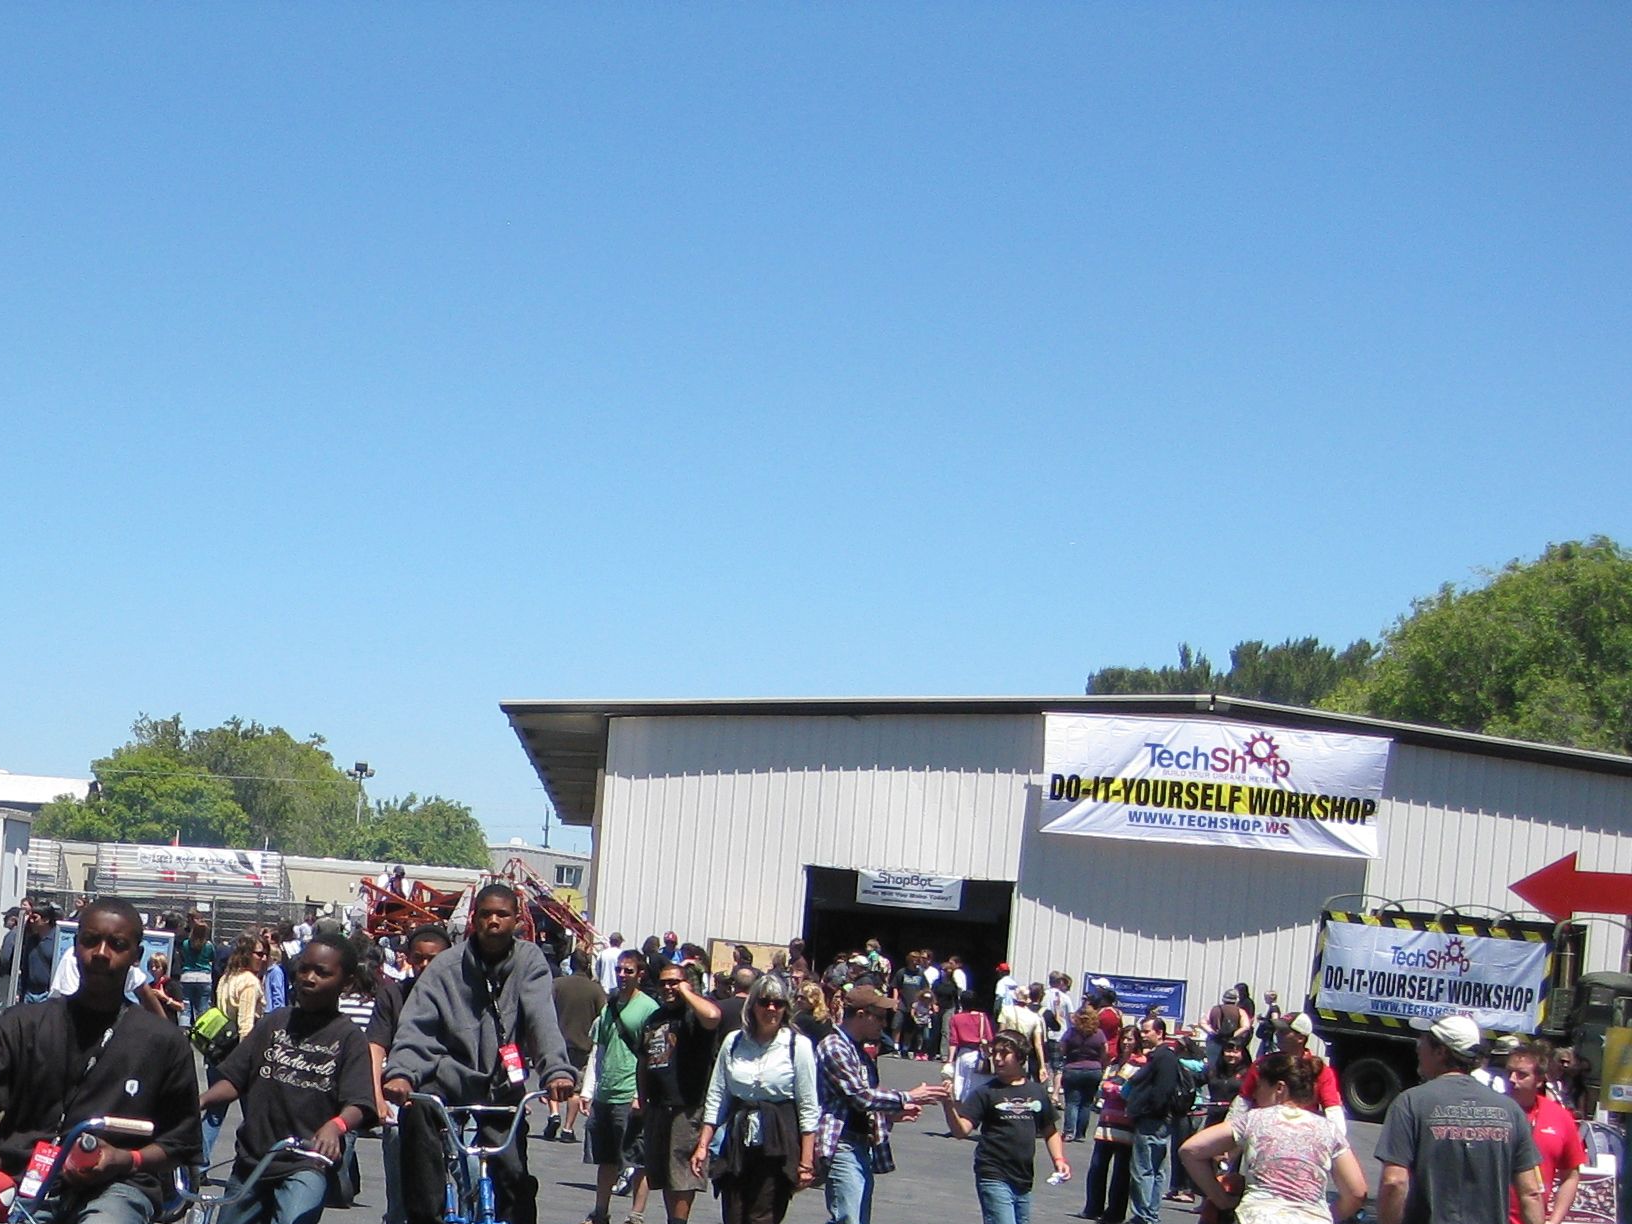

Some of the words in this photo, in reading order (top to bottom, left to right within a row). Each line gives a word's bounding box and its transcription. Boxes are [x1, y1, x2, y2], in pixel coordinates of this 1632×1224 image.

[1144, 731, 1290, 783] TechShop
[1188, 771, 1210, 779] YOUR
[1213, 773, 1247, 781] DREAMS
[1050, 773, 1242, 814] DO-IT-YOURSELF
[1248, 786, 1376, 826] WORKSHOP
[1128, 810, 1290, 835] WWW.TECHSHOP.WS
[873, 872, 943, 889] ShopBot
[1391, 937, 1470, 976] TechShop
[1324, 965, 1444, 1003] DO-IT-YOURSELF
[1448, 979, 1534, 1012] WORKSHOP
